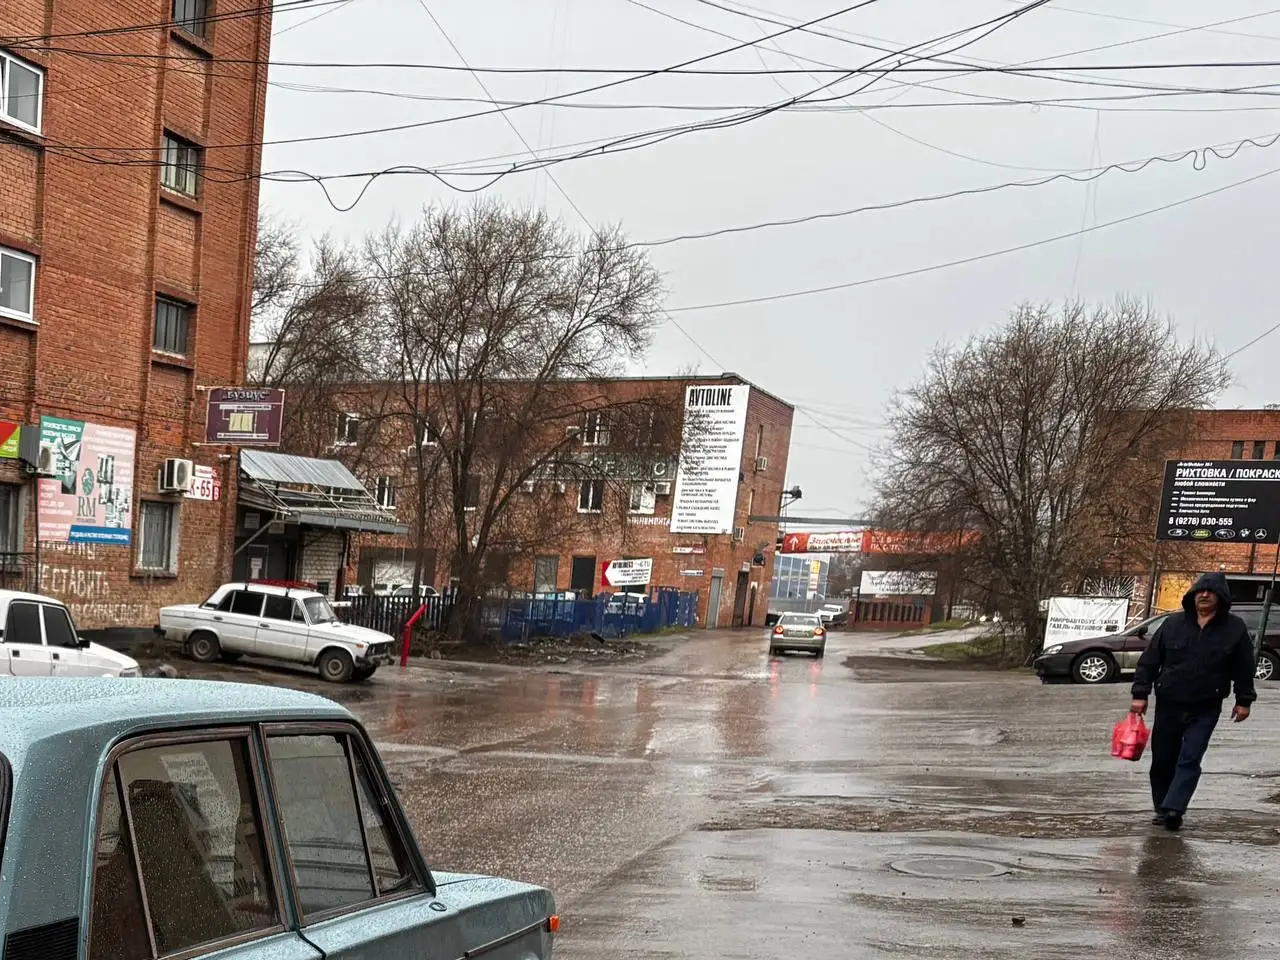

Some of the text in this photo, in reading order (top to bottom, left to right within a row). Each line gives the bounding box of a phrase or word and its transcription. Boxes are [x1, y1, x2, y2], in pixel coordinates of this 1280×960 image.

[688, 388, 732, 406] AVTOLINE
[1176, 468, 1227, 478] РИХТОВКА
[77, 496, 96, 517] RM
[52, 564, 110, 598] СТАВИТЬ
